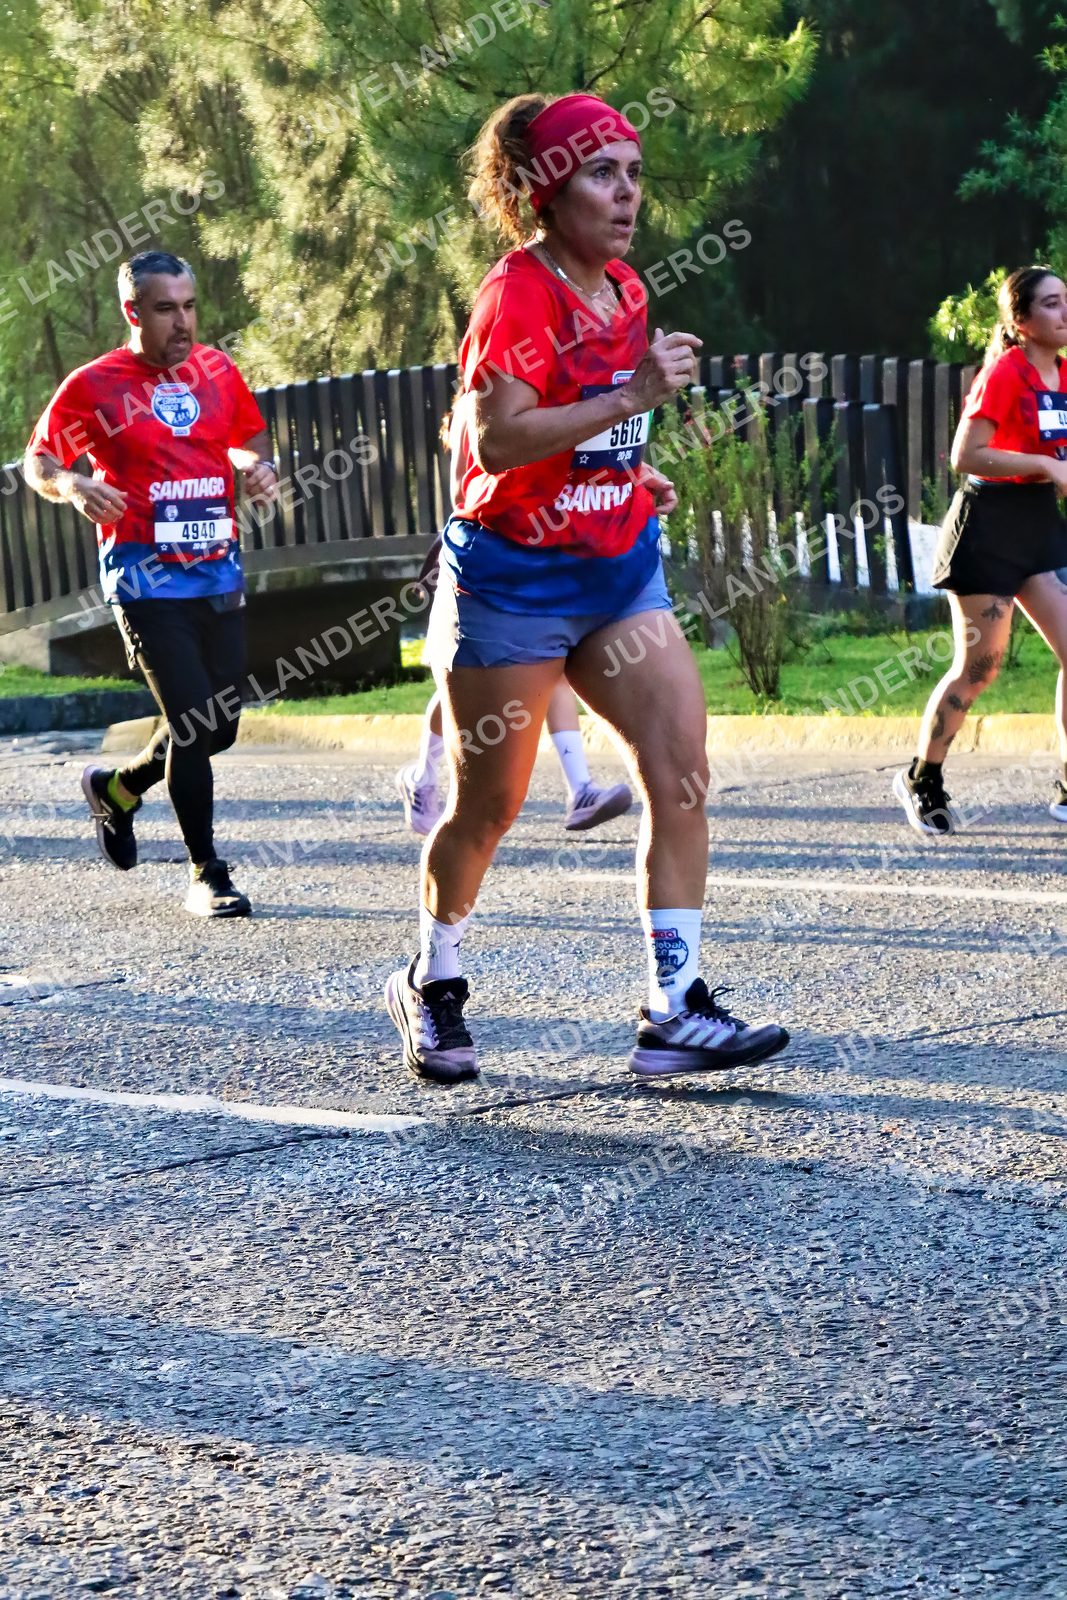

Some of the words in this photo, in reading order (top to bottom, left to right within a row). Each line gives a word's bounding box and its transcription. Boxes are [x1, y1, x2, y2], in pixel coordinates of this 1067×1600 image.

[610, 417, 642, 447] 5612
[149, 476, 225, 503] SANTIAGO
[182, 521, 216, 540] 4940
